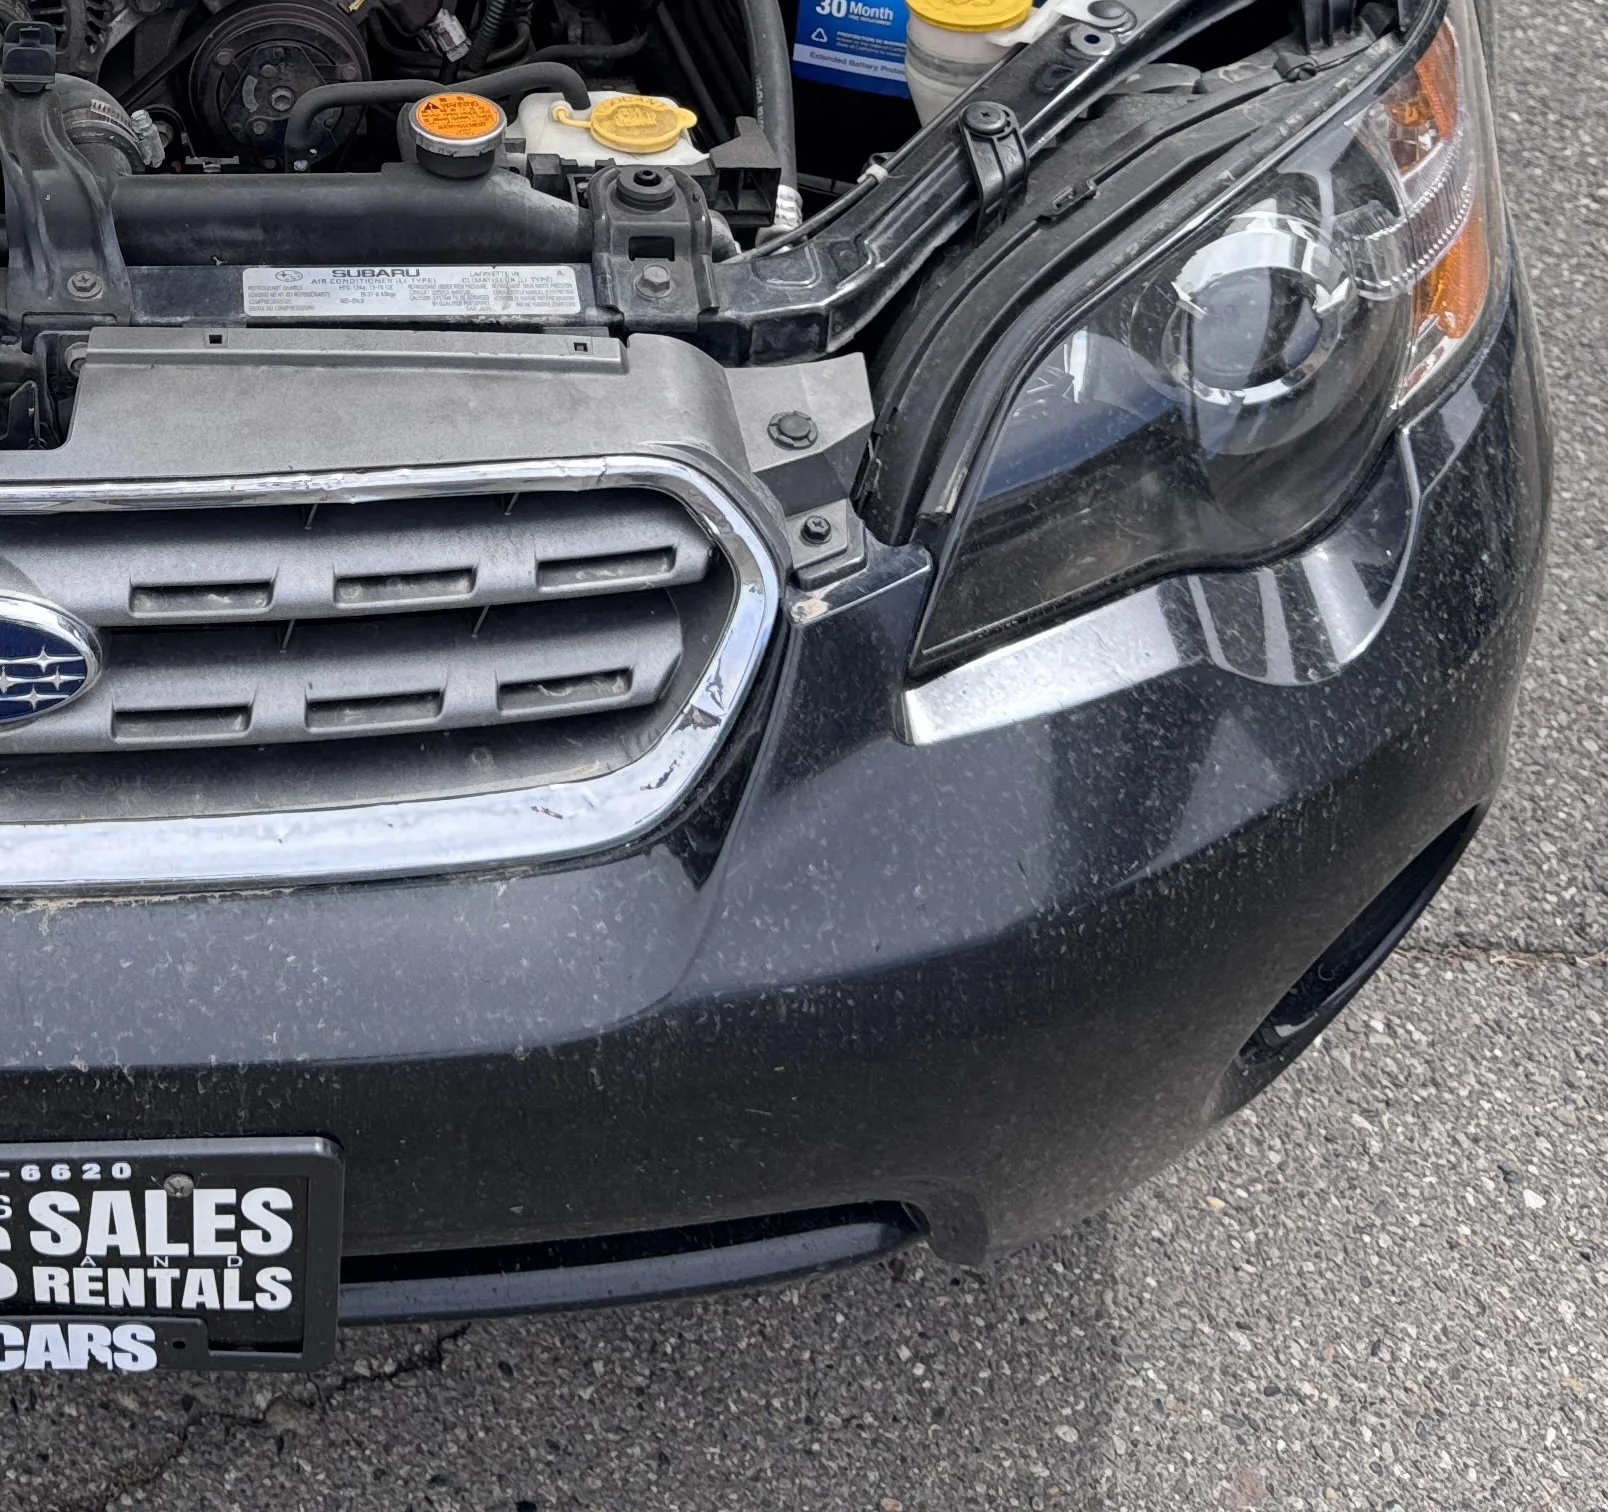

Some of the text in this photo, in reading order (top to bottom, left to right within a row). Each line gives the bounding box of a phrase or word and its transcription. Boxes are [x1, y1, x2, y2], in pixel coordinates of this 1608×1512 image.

[849, 0, 894, 21] Month
[848, 59, 879, 72] Battery
[332, 268, 421, 278] SUBARU
[28, 1187, 293, 1257] SALES
[32, 1266, 293, 1311] RENTALS
